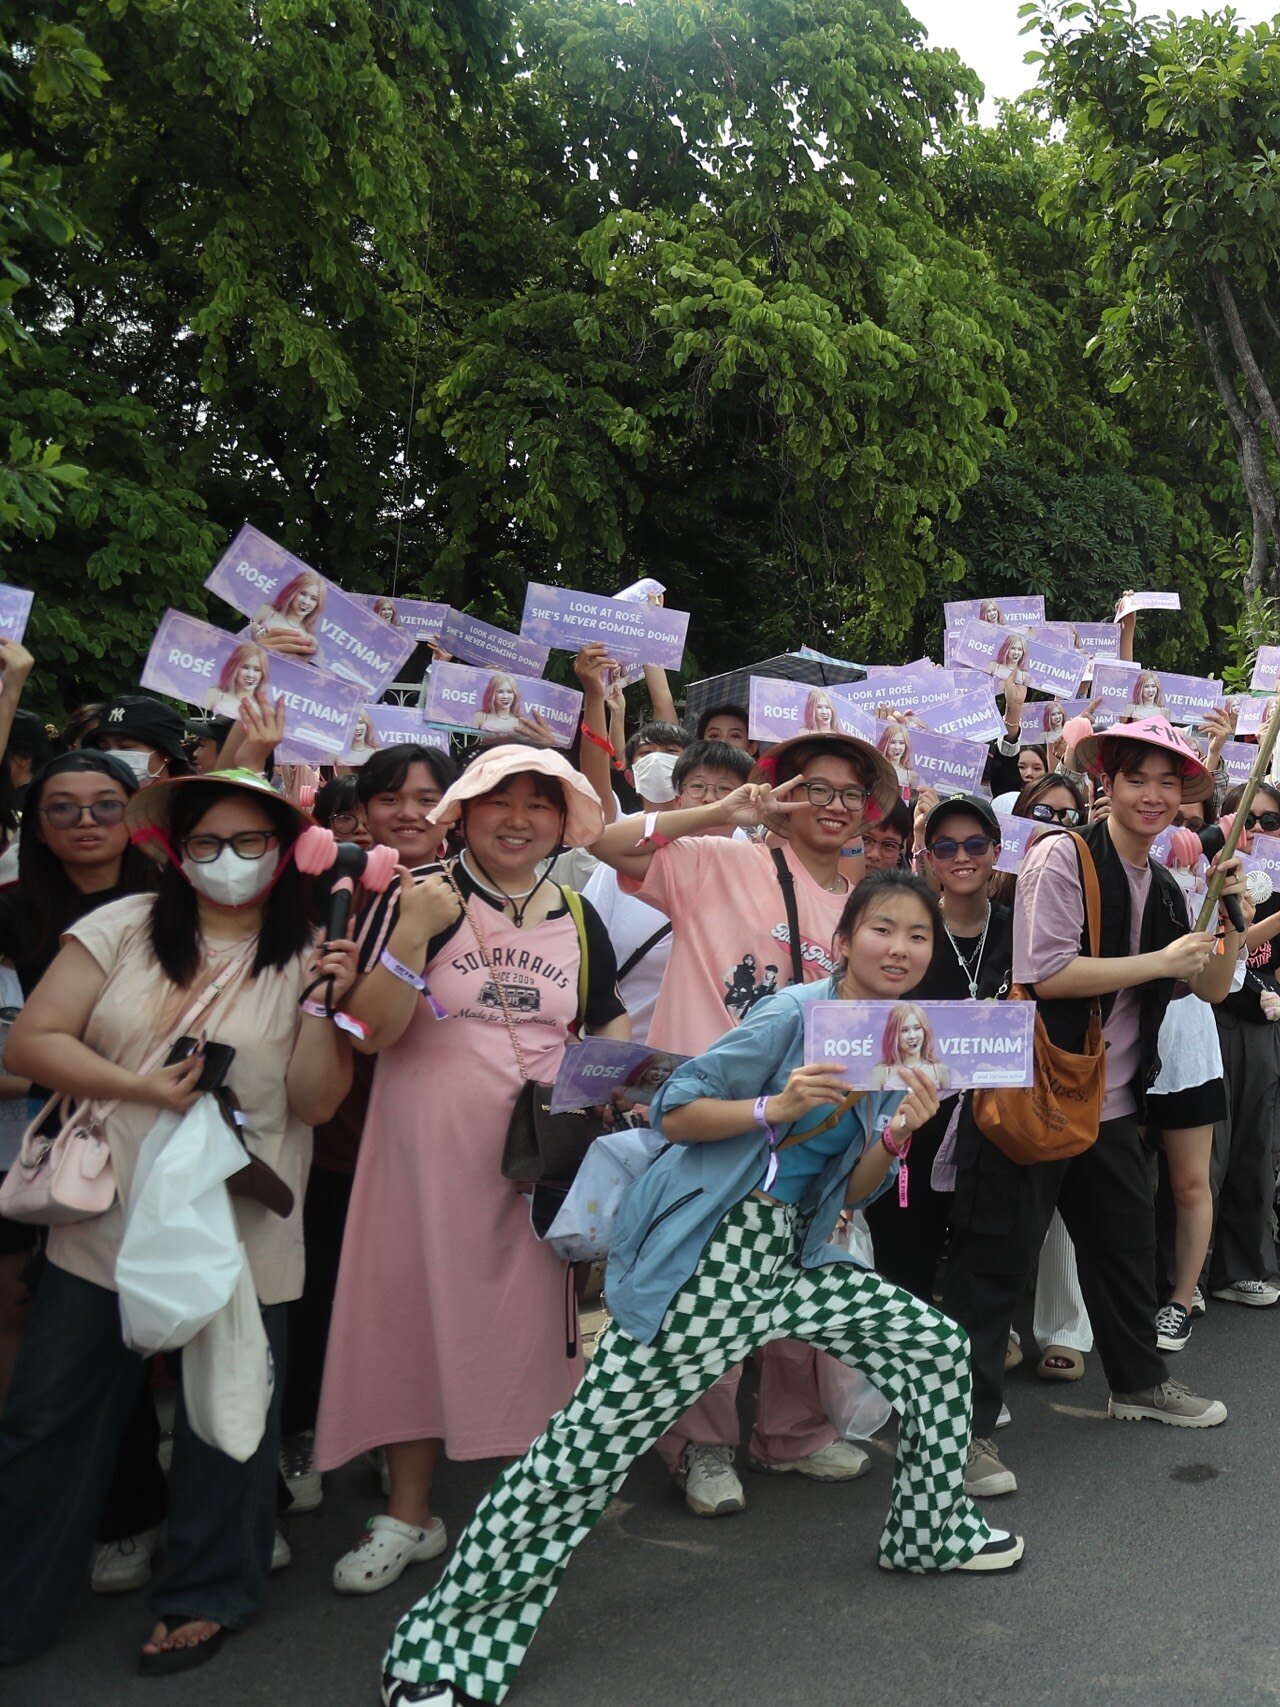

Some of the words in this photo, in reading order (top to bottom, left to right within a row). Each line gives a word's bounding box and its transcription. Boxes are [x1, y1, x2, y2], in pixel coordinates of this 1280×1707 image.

[235, 560, 280, 595] ROSÉ
[400, 616, 442, 628] VIETNAM
[570, 602, 597, 615] LOOK
[600, 608, 612, 618] AT
[615, 611, 644, 625] ROSÉ.
[1004, 612, 1040, 621] VIETNAM
[470, 626, 487, 638] LOOK
[488, 632, 496, 642] AT
[532, 608, 560, 620] SHE'S
[563, 614, 597, 629] NEVER
[599, 620, 644, 637] COMING
[647, 630, 679, 644] DOWN
[320, 618, 390, 675] VIETNAM
[968, 639, 995, 656] ROSÉ
[1081, 638, 1115, 646] VIETNAM
[464, 634, 486, 647] NEVER
[486, 643, 517, 659] COMING
[518, 655, 541, 669] DOWN
[168, 648, 215, 678] ROSÉ
[1029, 659, 1076, 682] VIETNAM
[1260, 664, 1278, 674] ROSÉ
[442, 688, 478, 704] ROSÉ
[848, 688, 872, 700] LOOK
[875, 688, 886, 697] AT
[889, 682, 915, 695] ROSÉ.
[1102, 686, 1128, 698] ROSÉ
[272, 686, 348, 727] VIETNAM
[877, 696, 918, 709] COMING
[922, 692, 950, 703] DOWN
[1164, 694, 1214, 708] VIETNAM
[764, 706, 798, 721] ROSÉ
[934, 709, 992, 734] VIETNAM
[1244, 712, 1260, 721] ROSÉ
[1021, 718, 1039, 729] OSÉ
[378, 730, 441, 746] VIETNAM
[914, 754, 975, 778] VIETNAM
[452, 948, 569, 989] SOURKRAUTS
[453, 1008, 485, 1019] Made
[824, 1034, 873, 1056] ROSÉ
[938, 1037, 1022, 1055] VIETNAM
[581, 1064, 626, 1079] ROSÉ
